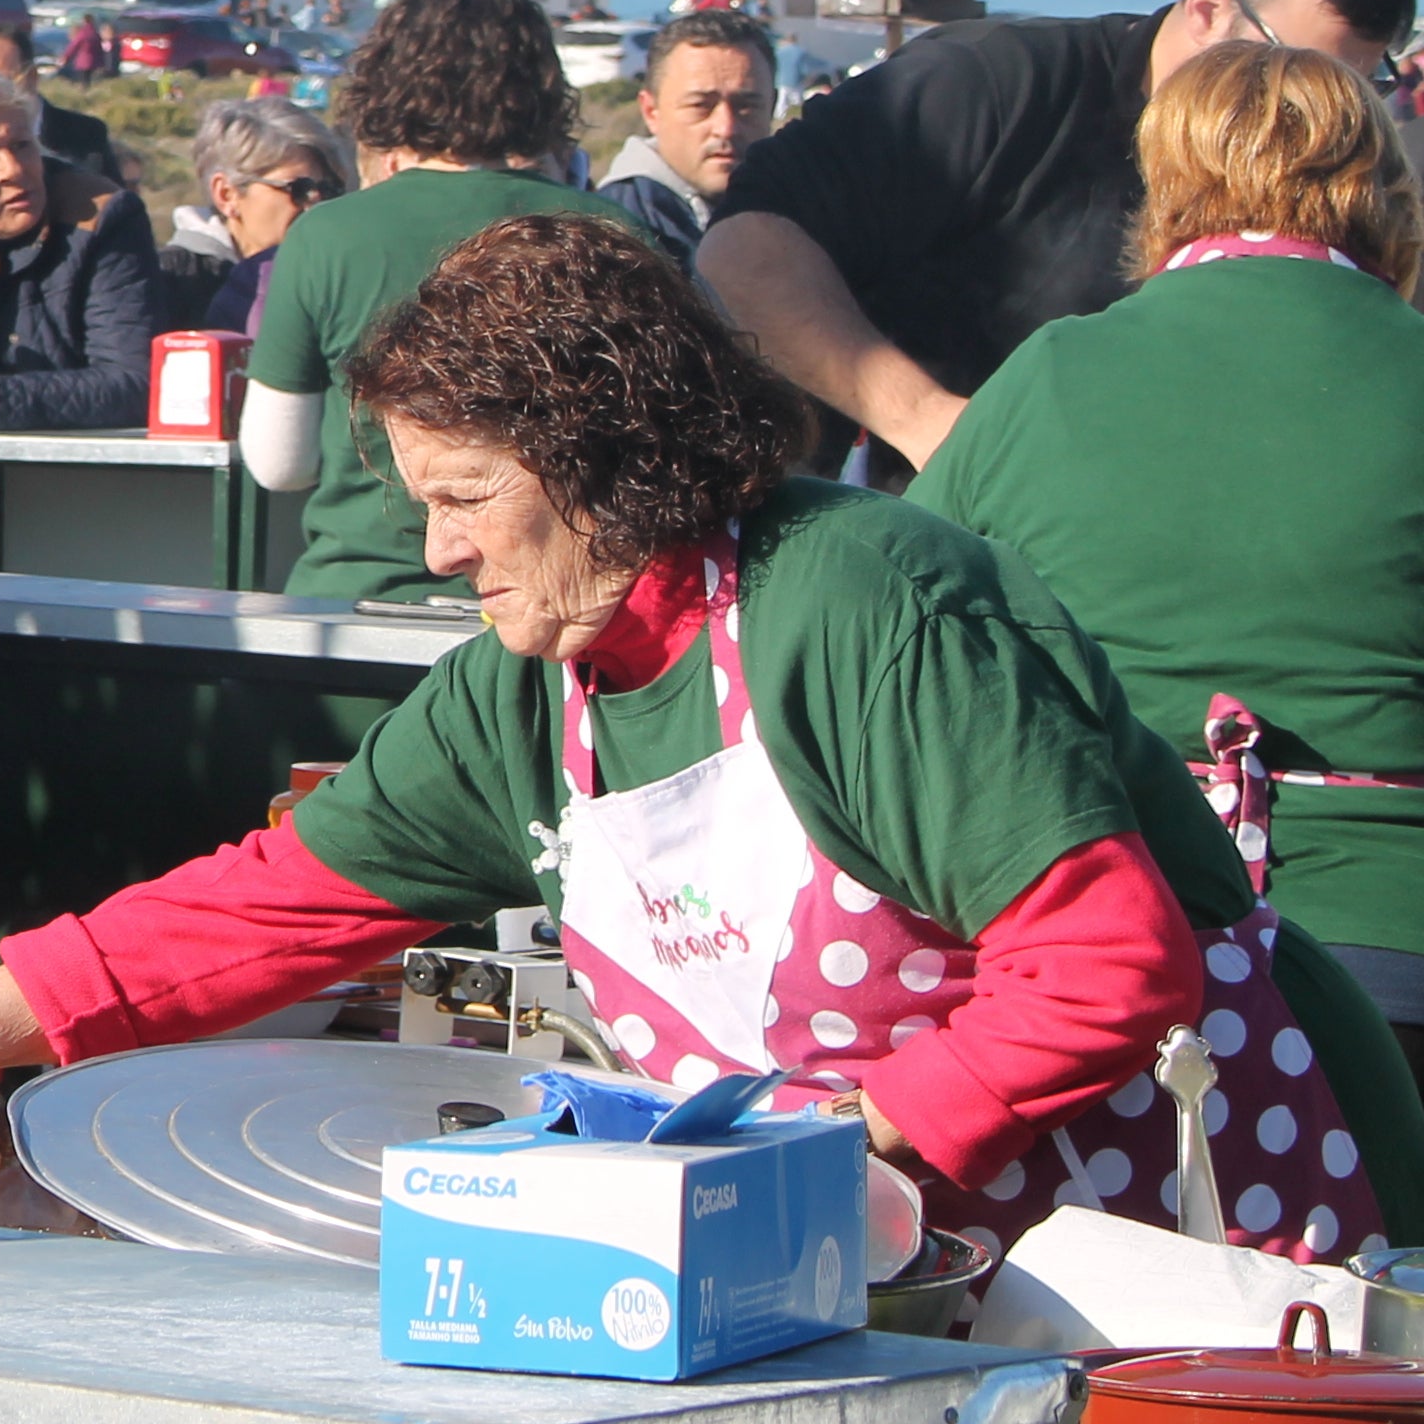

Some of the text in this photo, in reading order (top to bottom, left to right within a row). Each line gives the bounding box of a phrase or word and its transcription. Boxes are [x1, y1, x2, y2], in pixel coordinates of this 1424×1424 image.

[403, 1166, 518, 1199] CEGASA
[692, 1182, 739, 1221] CEGASA
[611, 1286, 663, 1317] 100%
[408, 1329, 481, 1345] TAMANHO MEDIO
[410, 1319, 479, 1334] TALLA MEDIANA
[513, 1313, 593, 1342] Sin Polvo
[611, 1307, 664, 1344] Nitrilo
